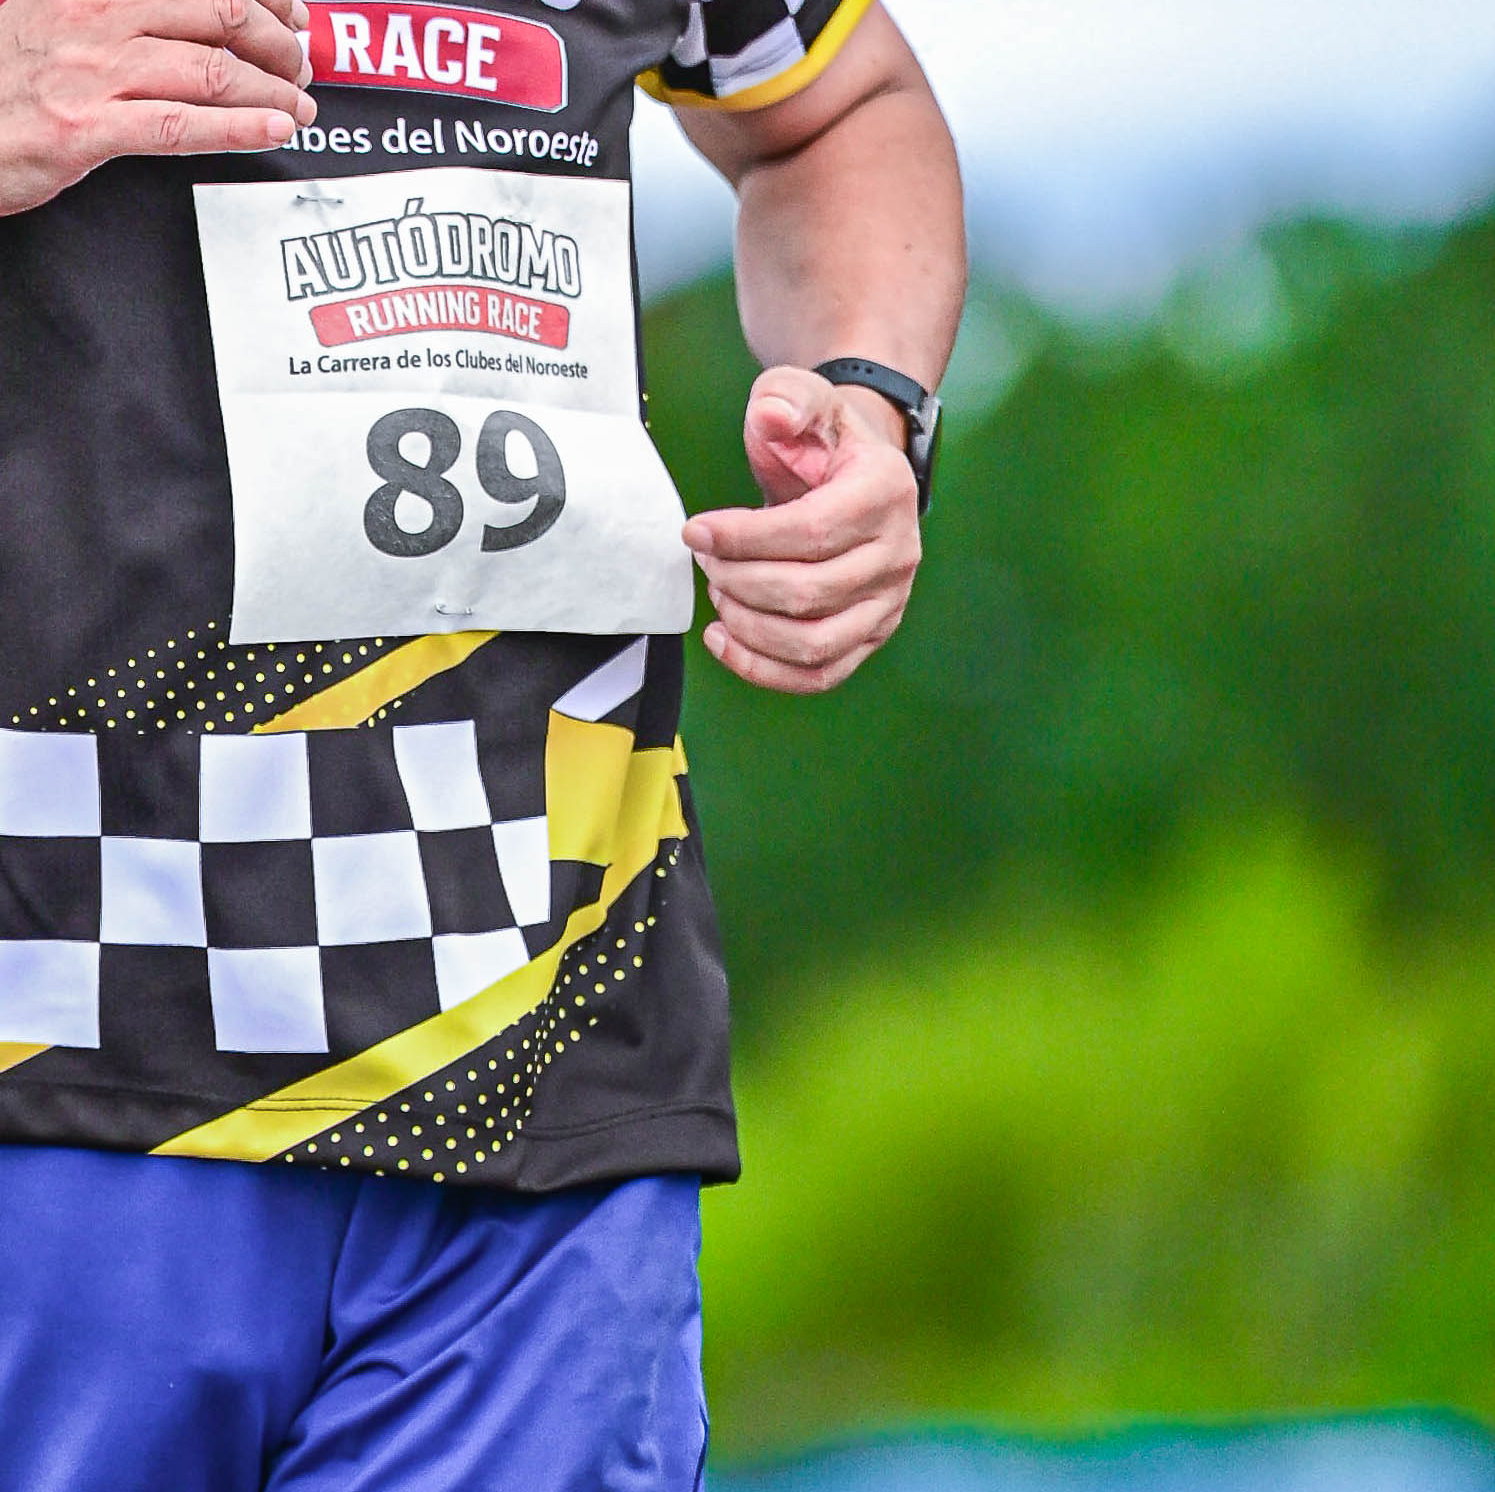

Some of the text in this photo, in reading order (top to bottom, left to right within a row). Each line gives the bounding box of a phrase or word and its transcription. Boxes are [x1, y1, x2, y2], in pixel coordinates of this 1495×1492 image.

[330, 11, 501, 92] RACE
[381, 116, 446, 155] del
[454, 119, 599, 168] Noroeste
[280, 196, 583, 301] AUTÓDROMO
[345, 289, 542, 342] RUNNING RACE
[289, 348, 589, 379] La Carrera de los Clubes del Noroeste
[363, 407, 567, 559] 89
